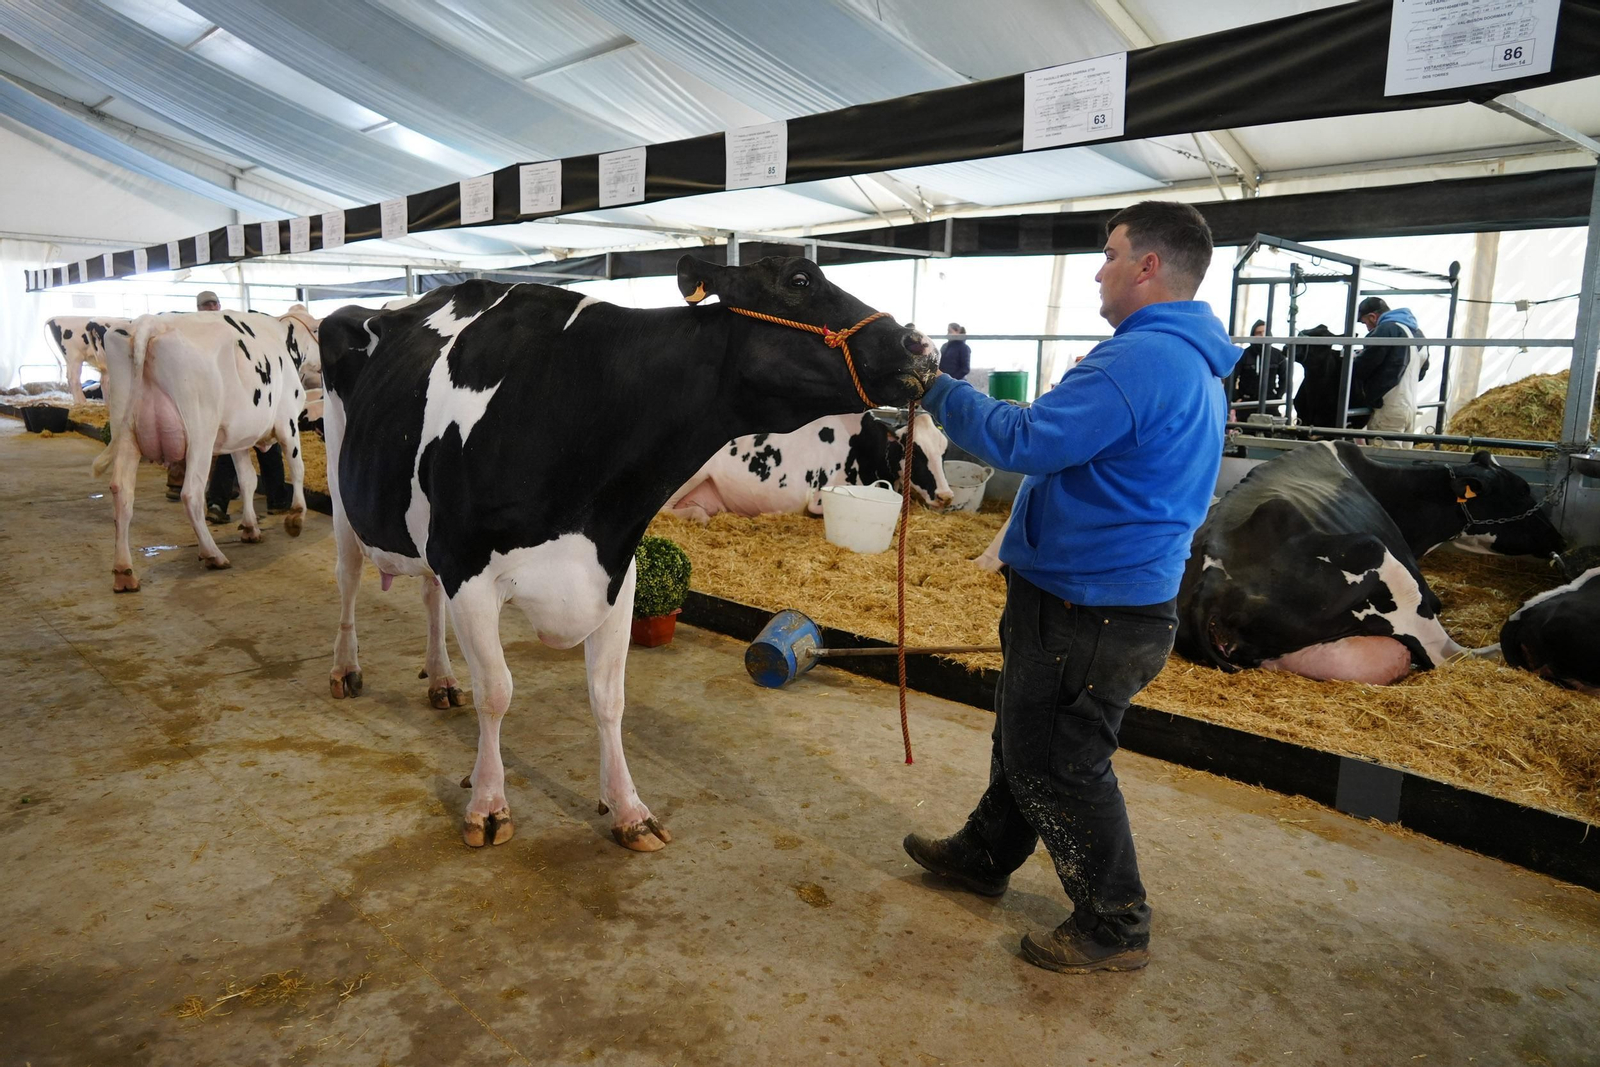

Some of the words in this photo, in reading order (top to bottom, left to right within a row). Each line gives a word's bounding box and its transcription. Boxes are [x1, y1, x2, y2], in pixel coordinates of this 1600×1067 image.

[1503, 46, 1523, 61] 86
[1094, 114, 1106, 125] 63
[768, 166, 776, 175] 85
